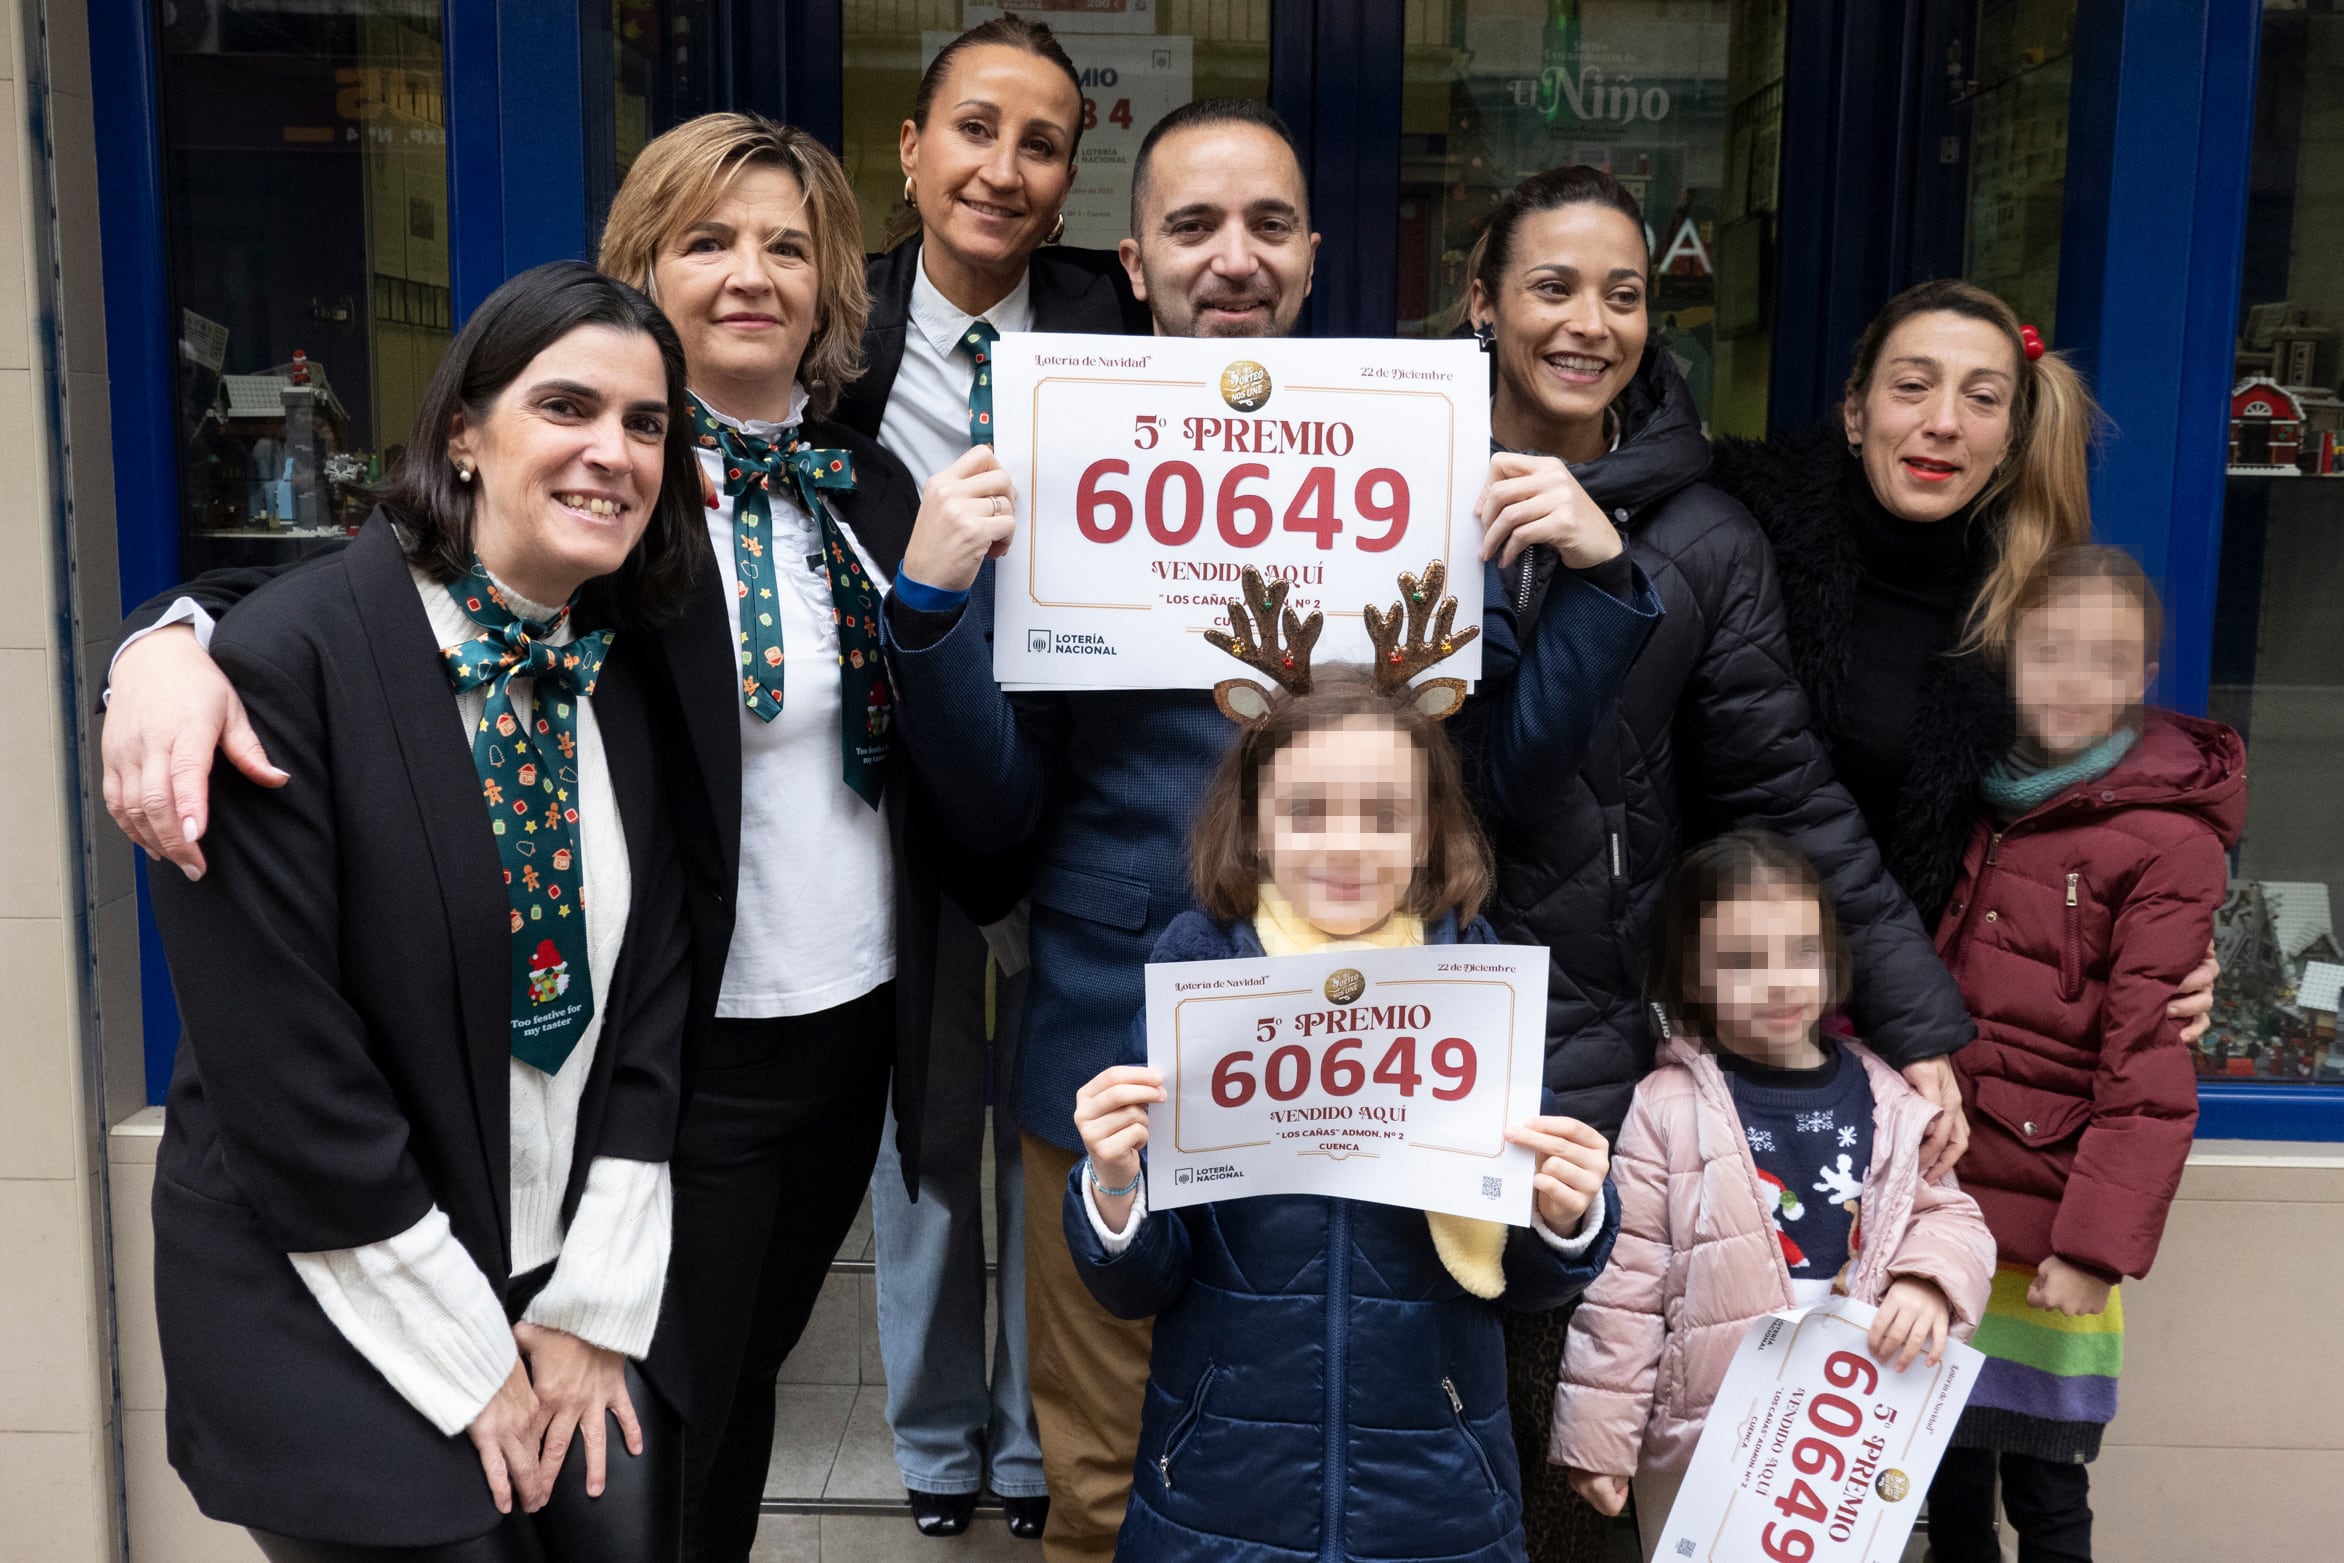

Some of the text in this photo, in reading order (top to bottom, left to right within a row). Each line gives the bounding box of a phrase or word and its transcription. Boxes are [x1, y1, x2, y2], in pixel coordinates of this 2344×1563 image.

[1506, 66, 1671, 125] El Niño
[1081, 146, 1117, 155] LOTERÍA
[1081, 155, 1127, 164] NACIONAL
[1035, 355, 1080, 367] Lotería
[1082, 355, 1097, 367] de
[1360, 367, 1454, 381] 22 de Diciembre
[1231, 384, 1263, 402] NOS UNE
[1134, 415, 1354, 457] 5º PREMIO
[1075, 458, 1411, 553] 60649
[1152, 561, 1324, 588] VENDID AQUÍ
[1295, 599, 1311, 608] Nº
[1313, 599, 1321, 609] 2
[1056, 631, 1104, 645] LOTERÍA
[1056, 644, 1117, 656] NACIONAL
[1438, 963, 1517, 973] 22 de Diciembre
[1175, 981, 1212, 992] Lotería
[1213, 980, 1225, 989] de
[510, 1004, 582, 1029] Too festive for
[1257, 1004, 1432, 1042] 5º PREMIO
[524, 1017, 572, 1037] my taster
[1211, 1036, 1478, 1108] 60649
[1270, 1105, 1406, 1124] VENDIDO AQUÍ
[1342, 1129, 1381, 1138] ADMON.
[1384, 1131, 1396, 1139] Nº
[1398, 1132, 1404, 1140] 2
[1319, 1143, 1359, 1151] CUENCA
[1196, 1164, 1235, 1175] LOTERÍA
[1196, 1171, 1245, 1183] NACIONAL
[1741, 1416, 1758, 1449] CUENCA
[1755, 1387, 1806, 1498] VENDIDO AQUÍ
[1761, 1350, 1879, 1563] 60649
[1828, 1435, 1886, 1543] PREMIO
